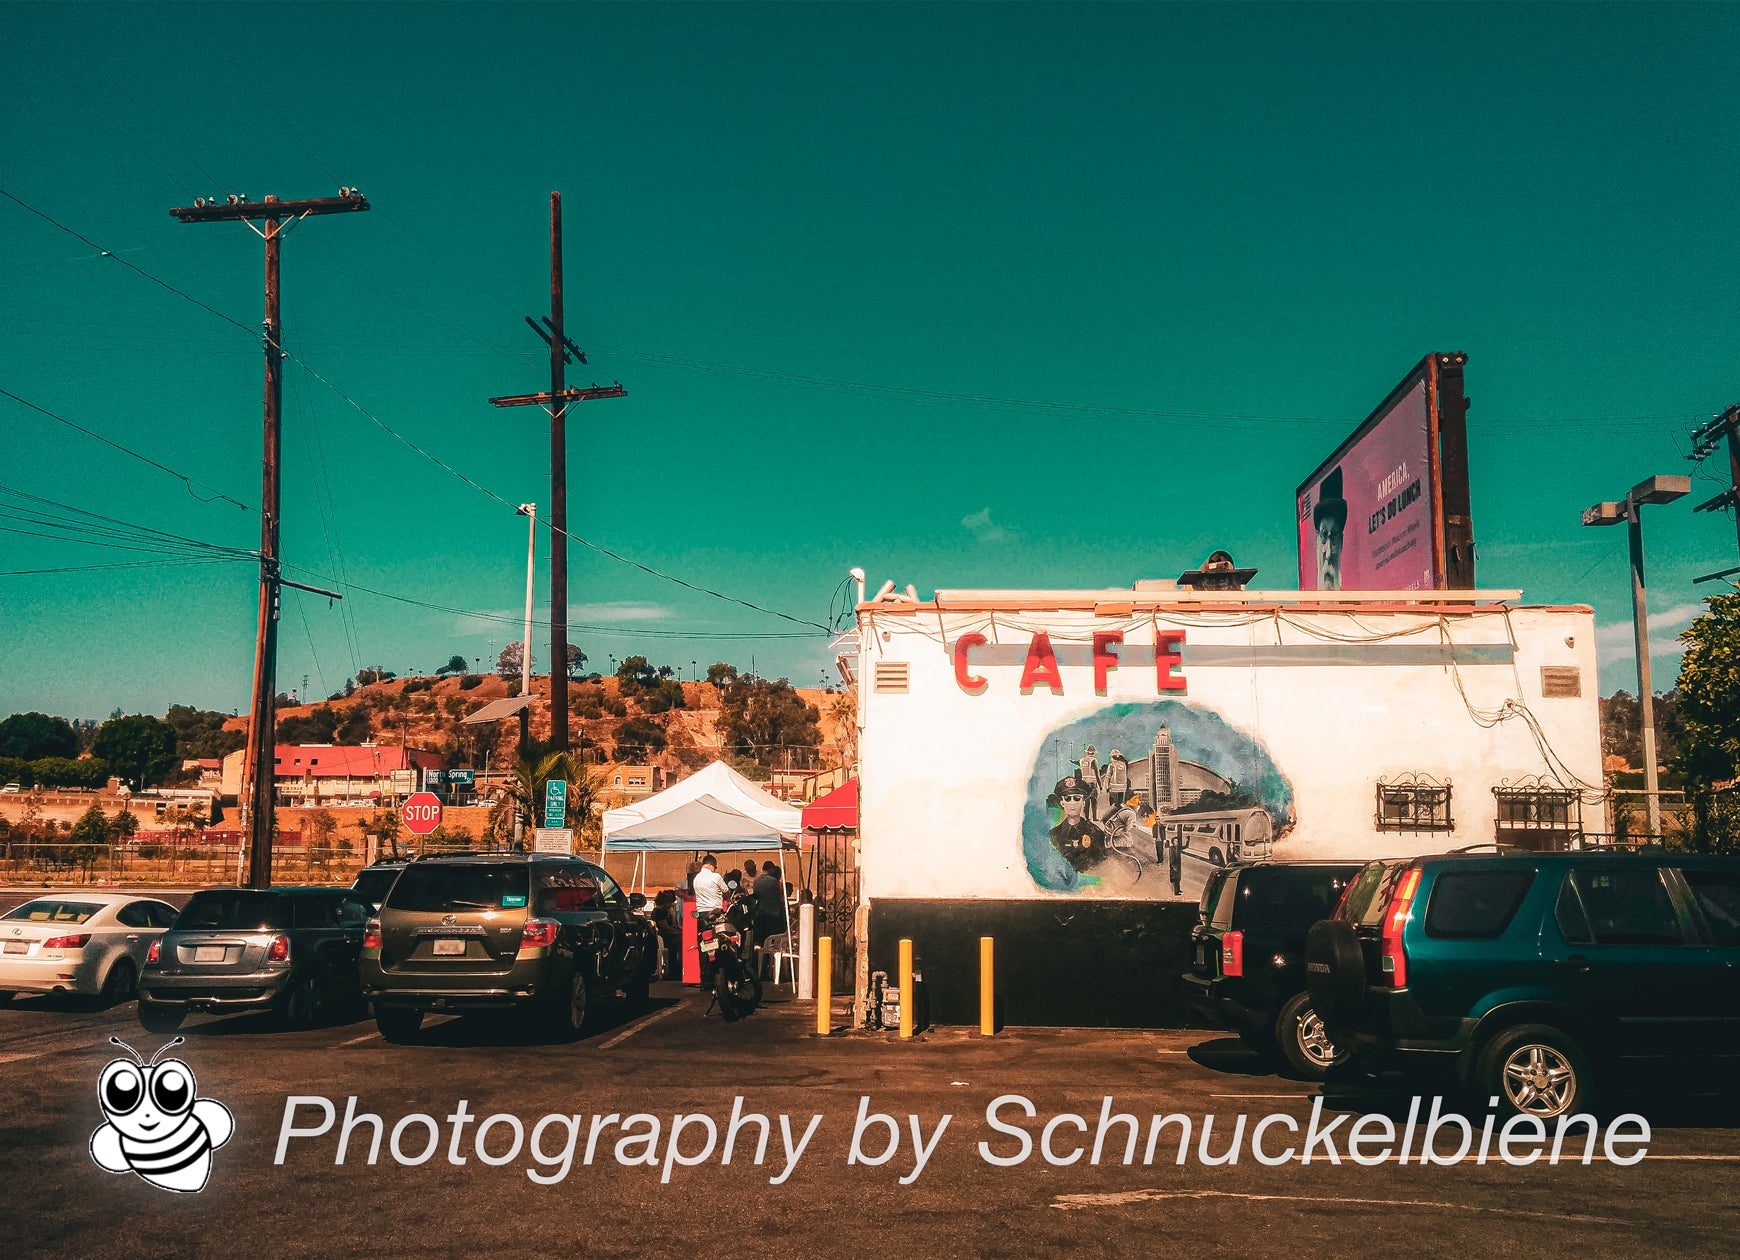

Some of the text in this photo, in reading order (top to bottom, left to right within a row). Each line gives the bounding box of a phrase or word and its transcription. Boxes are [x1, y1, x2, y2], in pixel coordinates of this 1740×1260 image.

[1368, 478, 1422, 535] LET'S DO LUNCH
[954, 630, 1188, 693] CAFE
[447, 770, 468, 780] Spring
[405, 805, 440, 821] STOP
